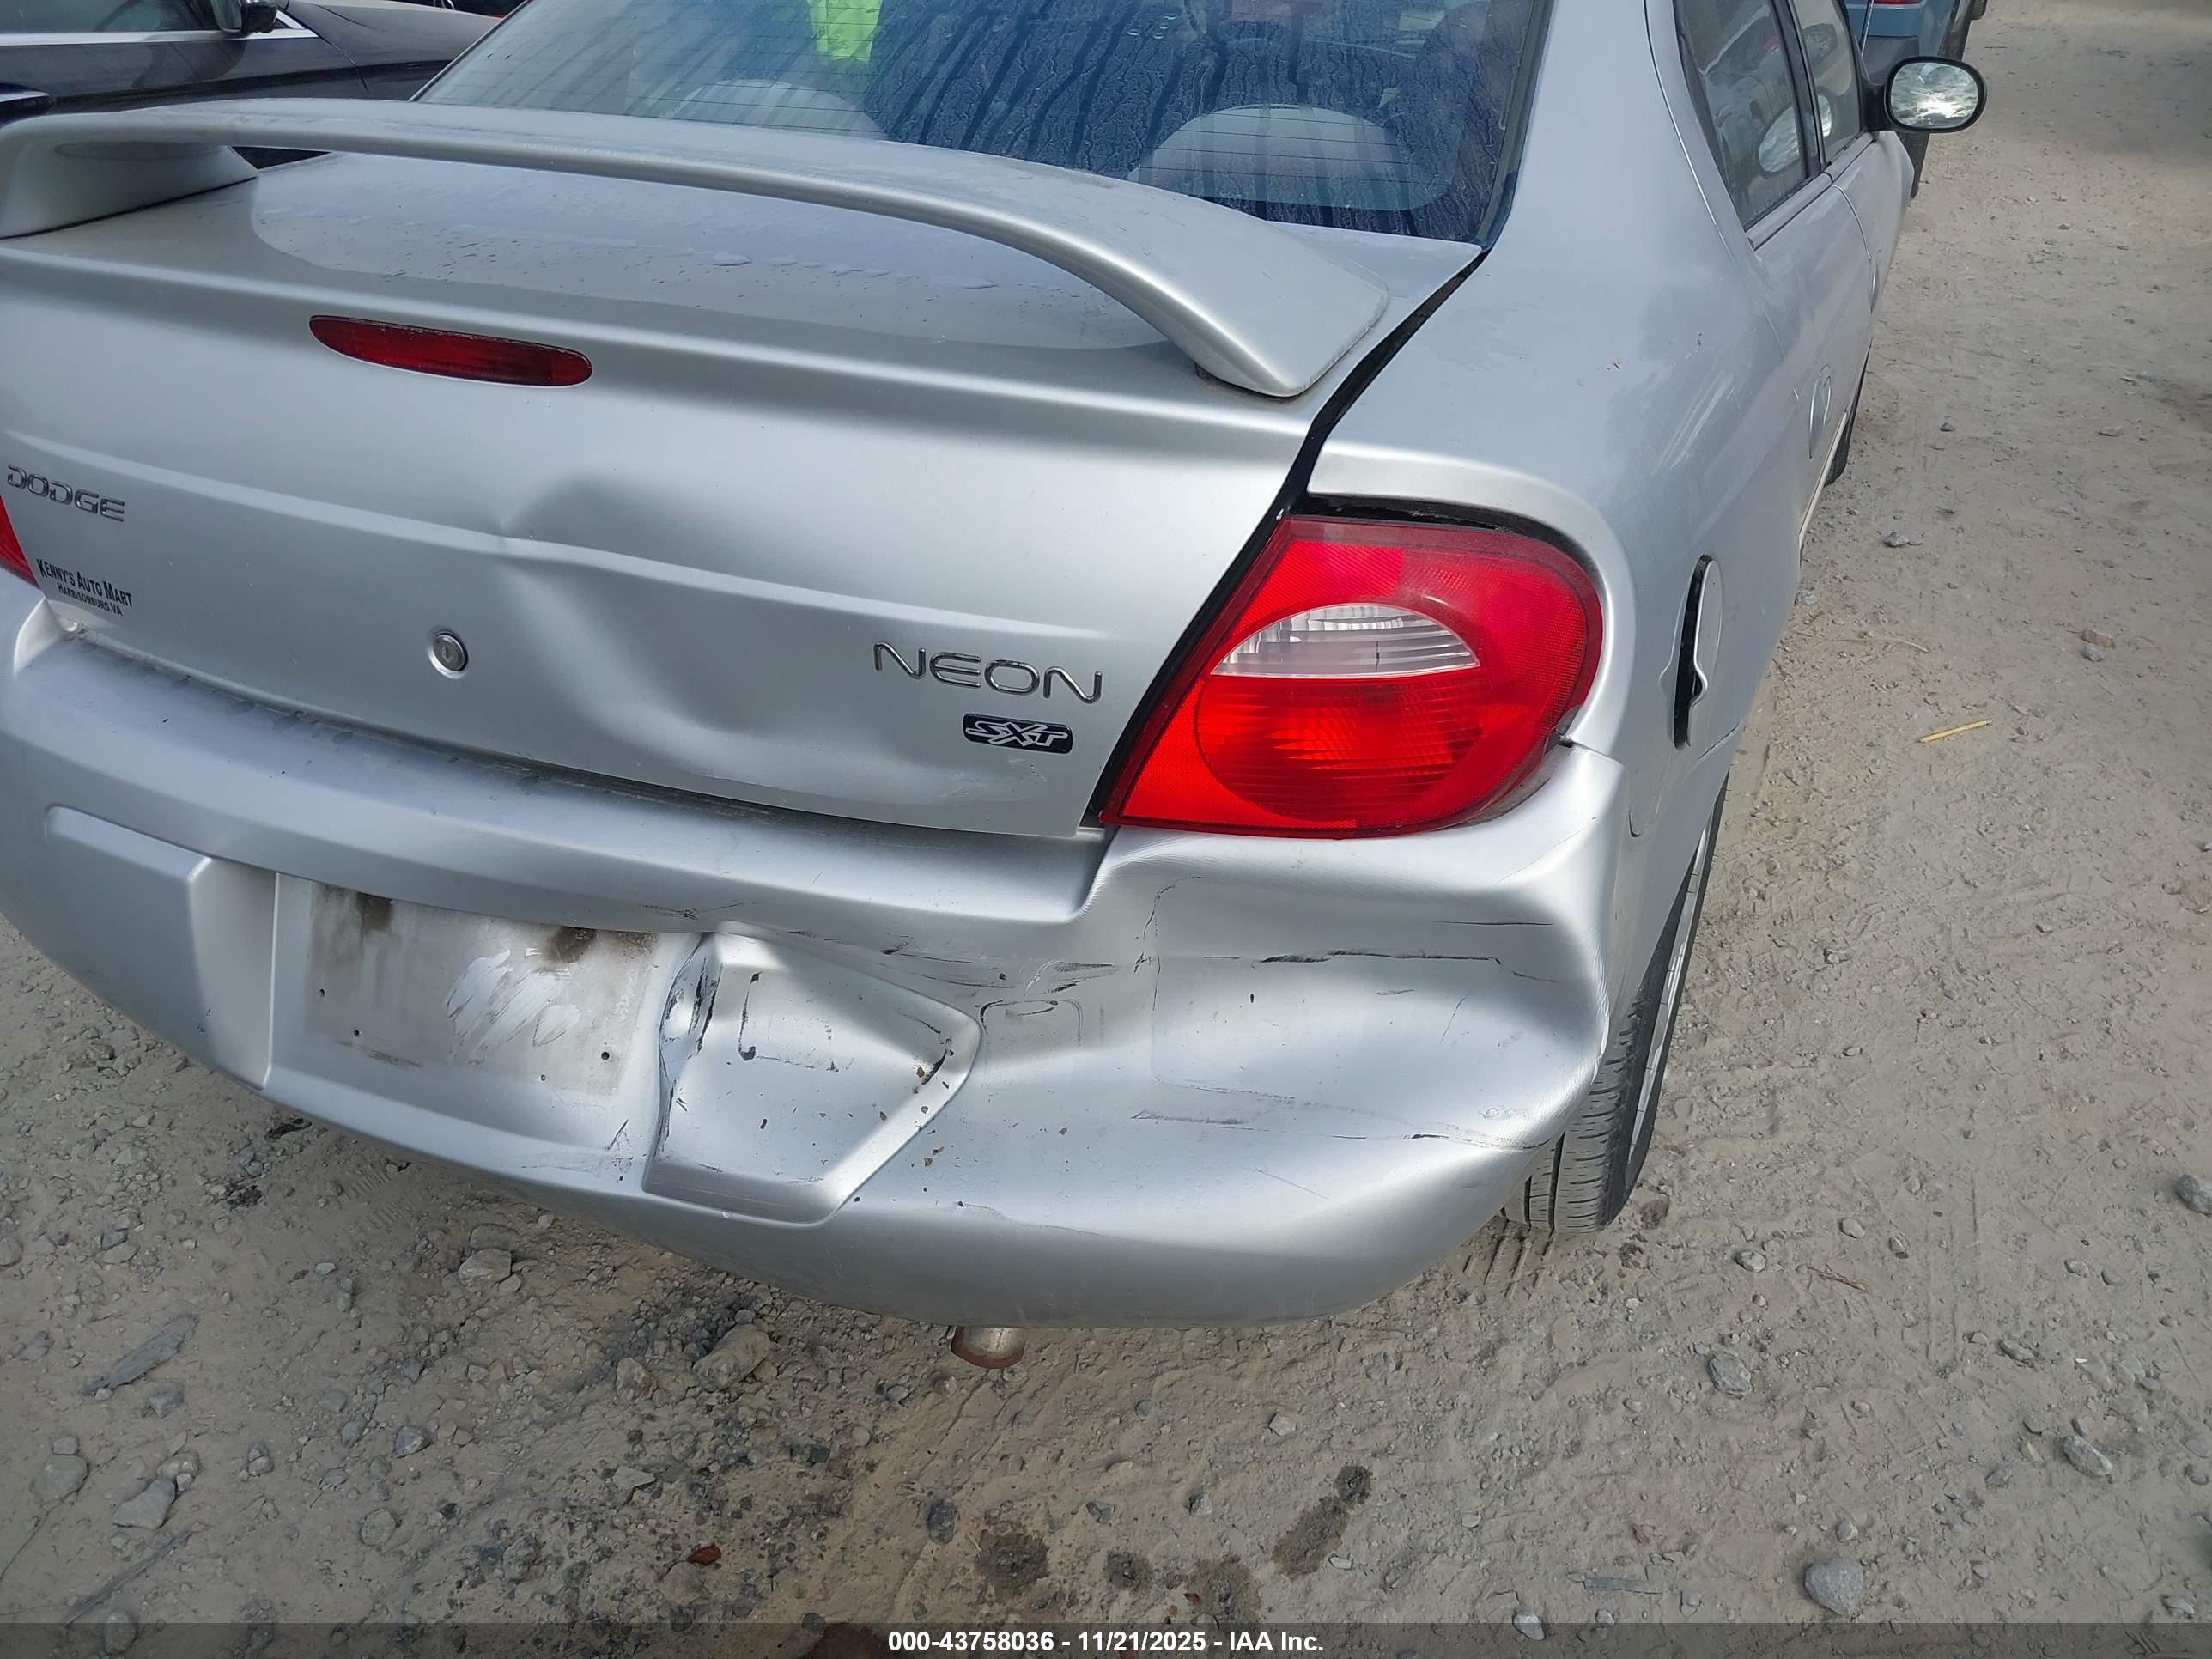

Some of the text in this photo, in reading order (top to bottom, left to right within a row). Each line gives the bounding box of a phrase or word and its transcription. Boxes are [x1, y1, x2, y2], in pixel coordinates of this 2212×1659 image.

[7, 465, 125, 522] DODGE
[873, 641, 1103, 704] NEON
[965, 720, 1069, 747] SXT
